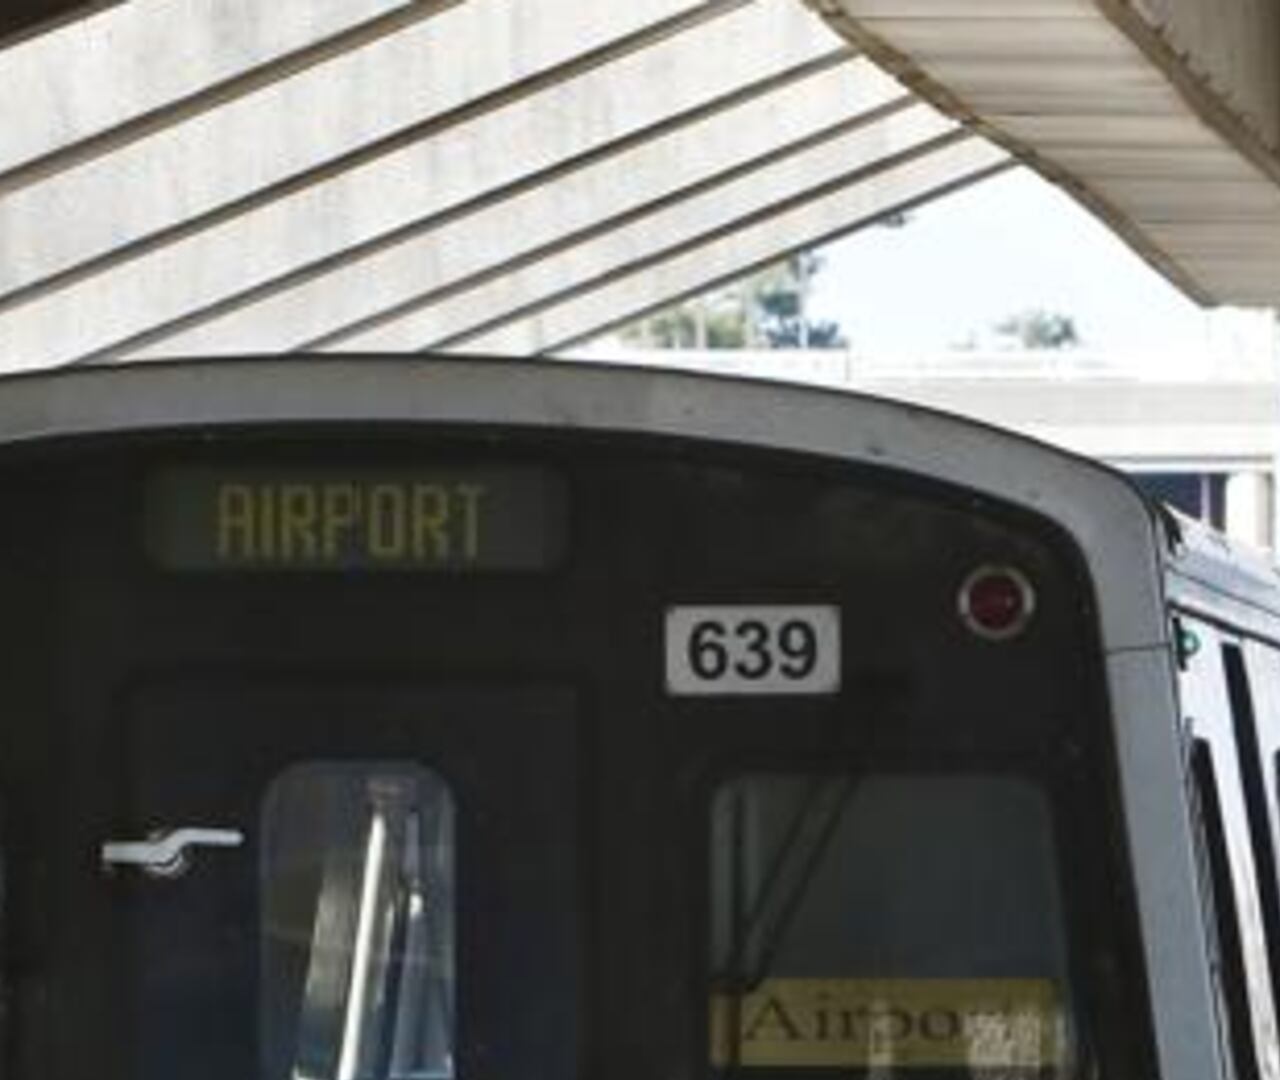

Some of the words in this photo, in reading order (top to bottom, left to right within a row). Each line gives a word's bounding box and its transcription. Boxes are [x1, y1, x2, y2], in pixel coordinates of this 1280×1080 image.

[216, 482, 487, 560] AIRPORT
[688, 619, 818, 683] 639
[744, 991, 1022, 1053] Airpo
